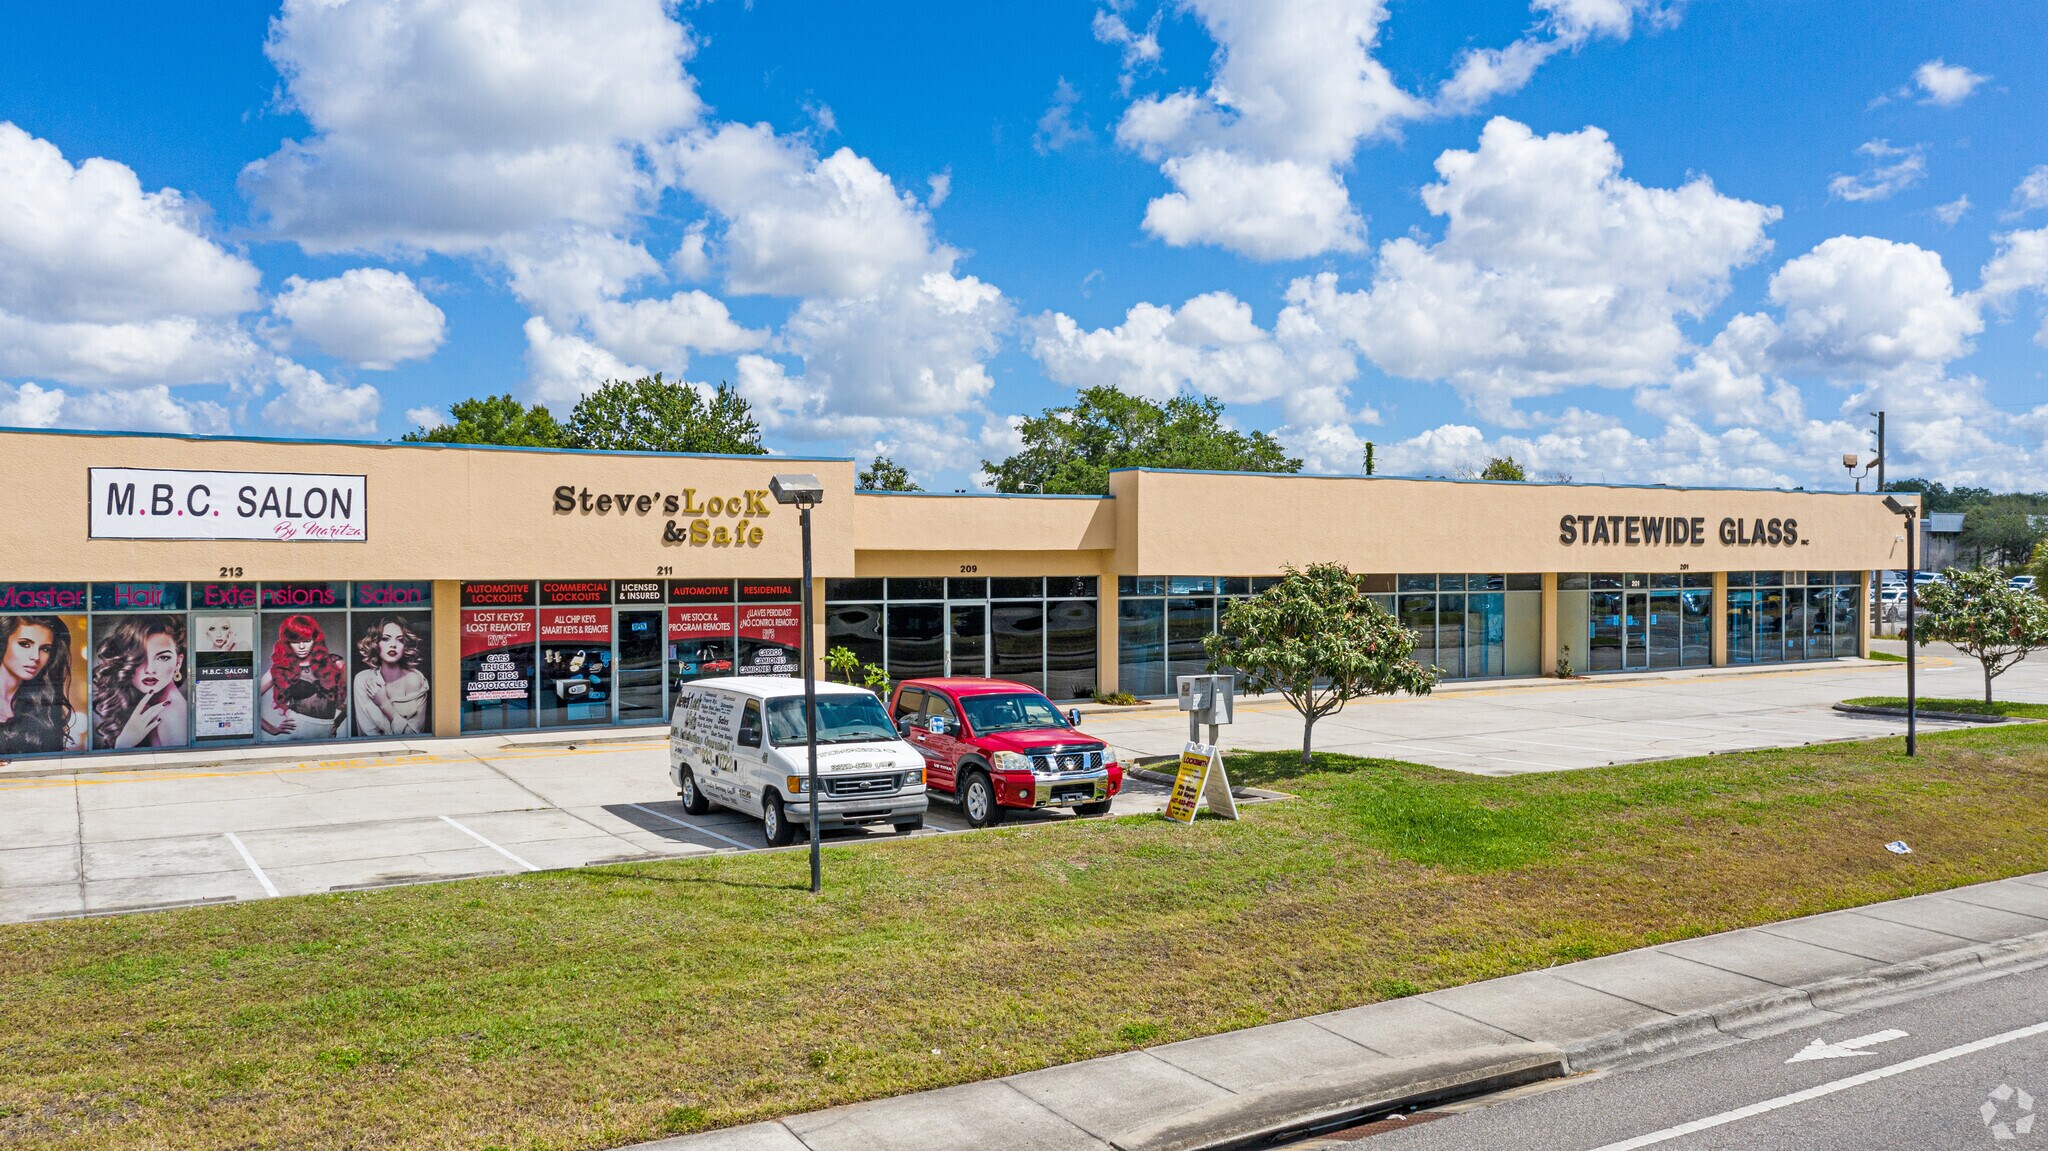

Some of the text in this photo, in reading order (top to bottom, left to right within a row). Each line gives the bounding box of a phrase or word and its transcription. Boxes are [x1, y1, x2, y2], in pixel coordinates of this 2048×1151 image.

[107, 483, 353, 520] M.B.C. SALON
[273, 521, 364, 540] By Maritza
[663, 518, 764, 544] & Safe
[1560, 514, 1705, 545] STATEWIDE
[1719, 517, 1799, 546] GLASS
[219, 567, 244, 578] 213
[657, 566, 673, 576] 211
[960, 565, 978, 573] 209
[466, 584, 529, 594] AUTOMOTIVE
[543, 583, 608, 593] COMMERCIAL
[621, 583, 659, 592] LICENSED
[673, 586, 729, 596] AUTOMOTIVE
[744, 585, 793, 595] RESIDENTIAL
[115, 585, 163, 606] Hair
[205, 585, 335, 606] Extensions
[361, 584, 421, 604] Salon
[472, 594, 523, 604] LOCKOUTS
[551, 592, 601, 602] LOCKOUTS
[627, 592, 660, 601] INSURED
[473, 612, 525, 622] LOST KEYS?
[567, 616, 581, 624] CHIP
[581, 615, 597, 624] KEYS
[691, 613, 712, 621] STOCK
[713, 613, 719, 621] &
[466, 622, 532, 633] LOST REMOTE?
[668, 622, 731, 632] PROGRAM REMOTES
[751, 618, 775, 627] CONTROL
[542, 624, 609, 635] SMART KEYS & REMOTE
[486, 653, 510, 663] CARS
[754, 656, 787, 665] CAMIONES
[480, 662, 516, 672] TRUCKS
[739, 664, 798, 674] CAMIONES GRANDE
[477, 671, 519, 681] BIG RIGS
